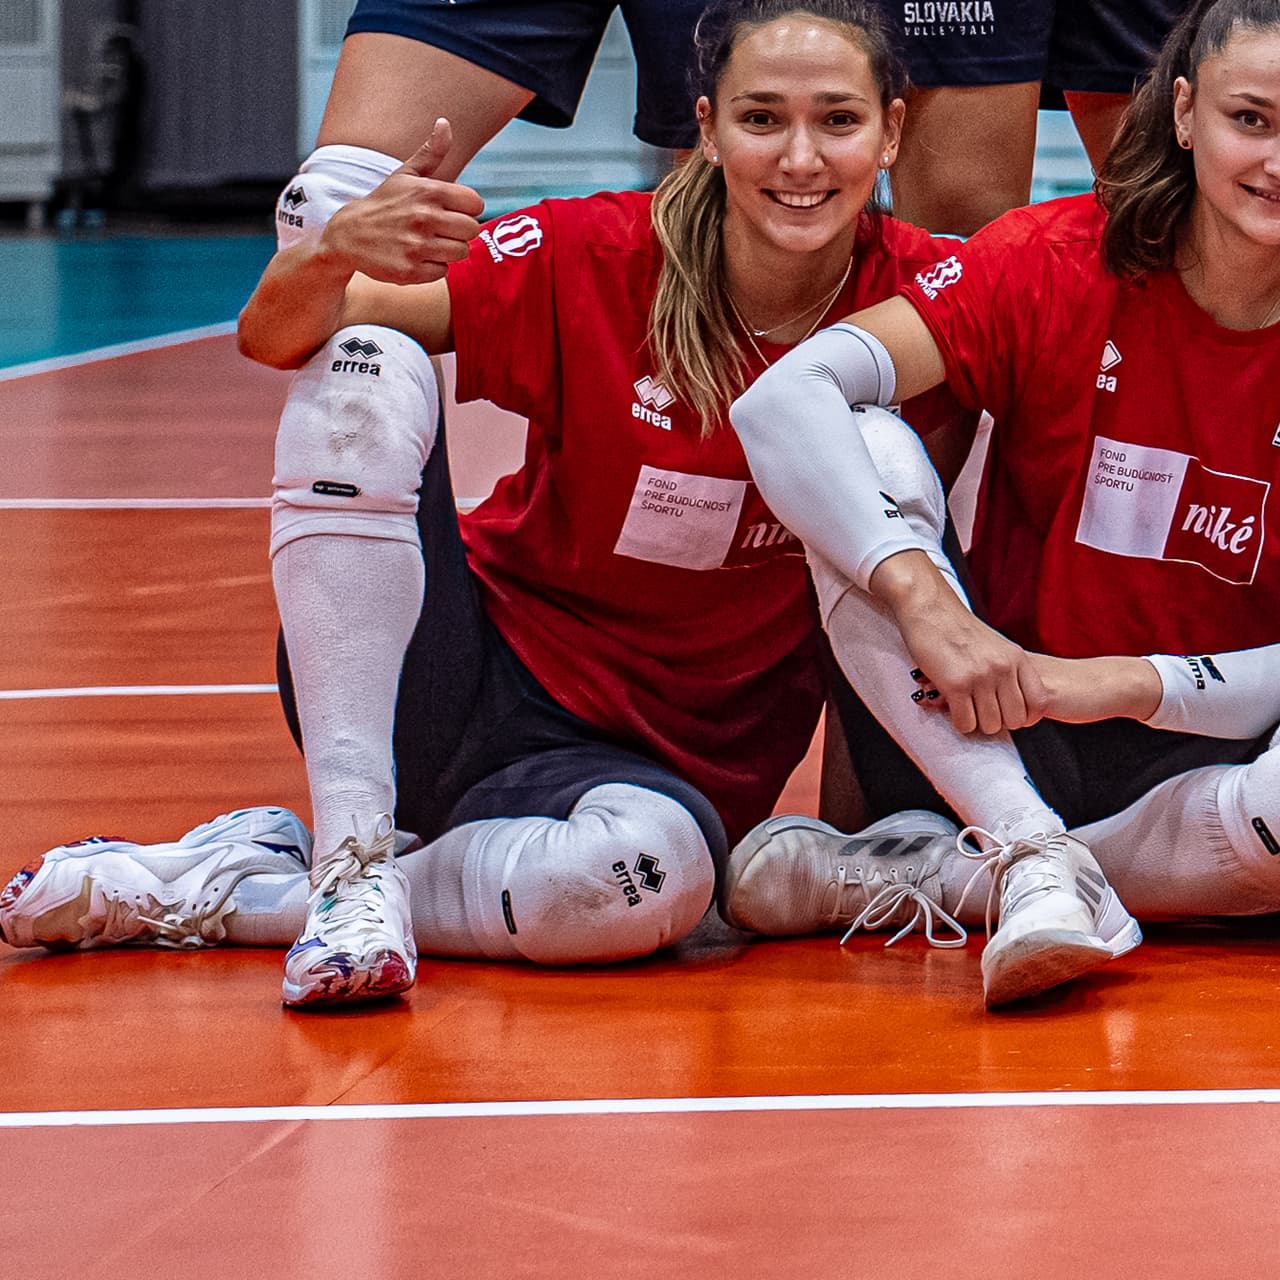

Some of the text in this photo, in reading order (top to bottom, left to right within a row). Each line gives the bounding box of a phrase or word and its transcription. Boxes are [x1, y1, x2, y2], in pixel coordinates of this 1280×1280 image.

[904, 0, 996, 24] SLOVAKIA
[331, 358, 382, 377] errea
[631, 401, 674, 431] errea
[1100, 447, 1127, 463] FOND
[1098, 461, 1117, 475] PRE
[648, 477, 678, 491] FOND
[1094, 474, 1135, 492] ŠPORTU
[645, 489, 666, 502] PRE
[641, 501, 684, 518] ŠPORTU
[1181, 503, 1256, 554] niké
[612, 860, 643, 908] errea
